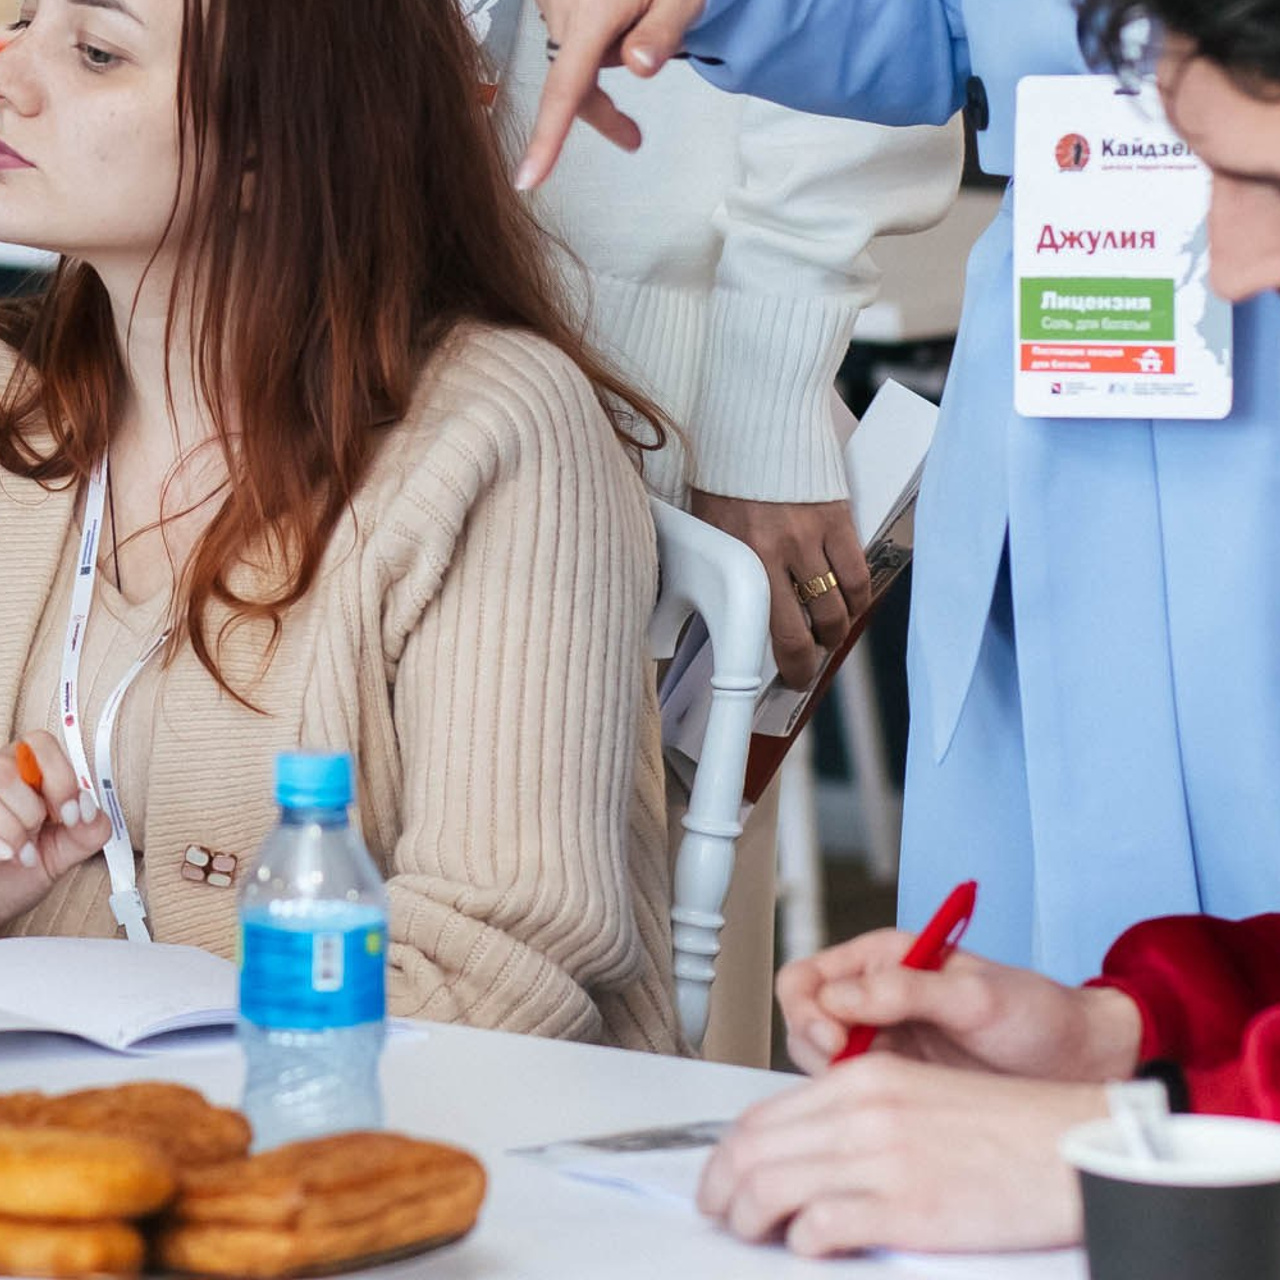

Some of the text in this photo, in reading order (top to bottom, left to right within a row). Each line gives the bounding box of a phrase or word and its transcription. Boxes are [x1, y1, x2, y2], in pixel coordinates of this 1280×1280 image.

[1037, 225, 1156, 255] Джулия
[1041, 290, 1152, 312] Лицензия
[1075, 318, 1099, 331] для
